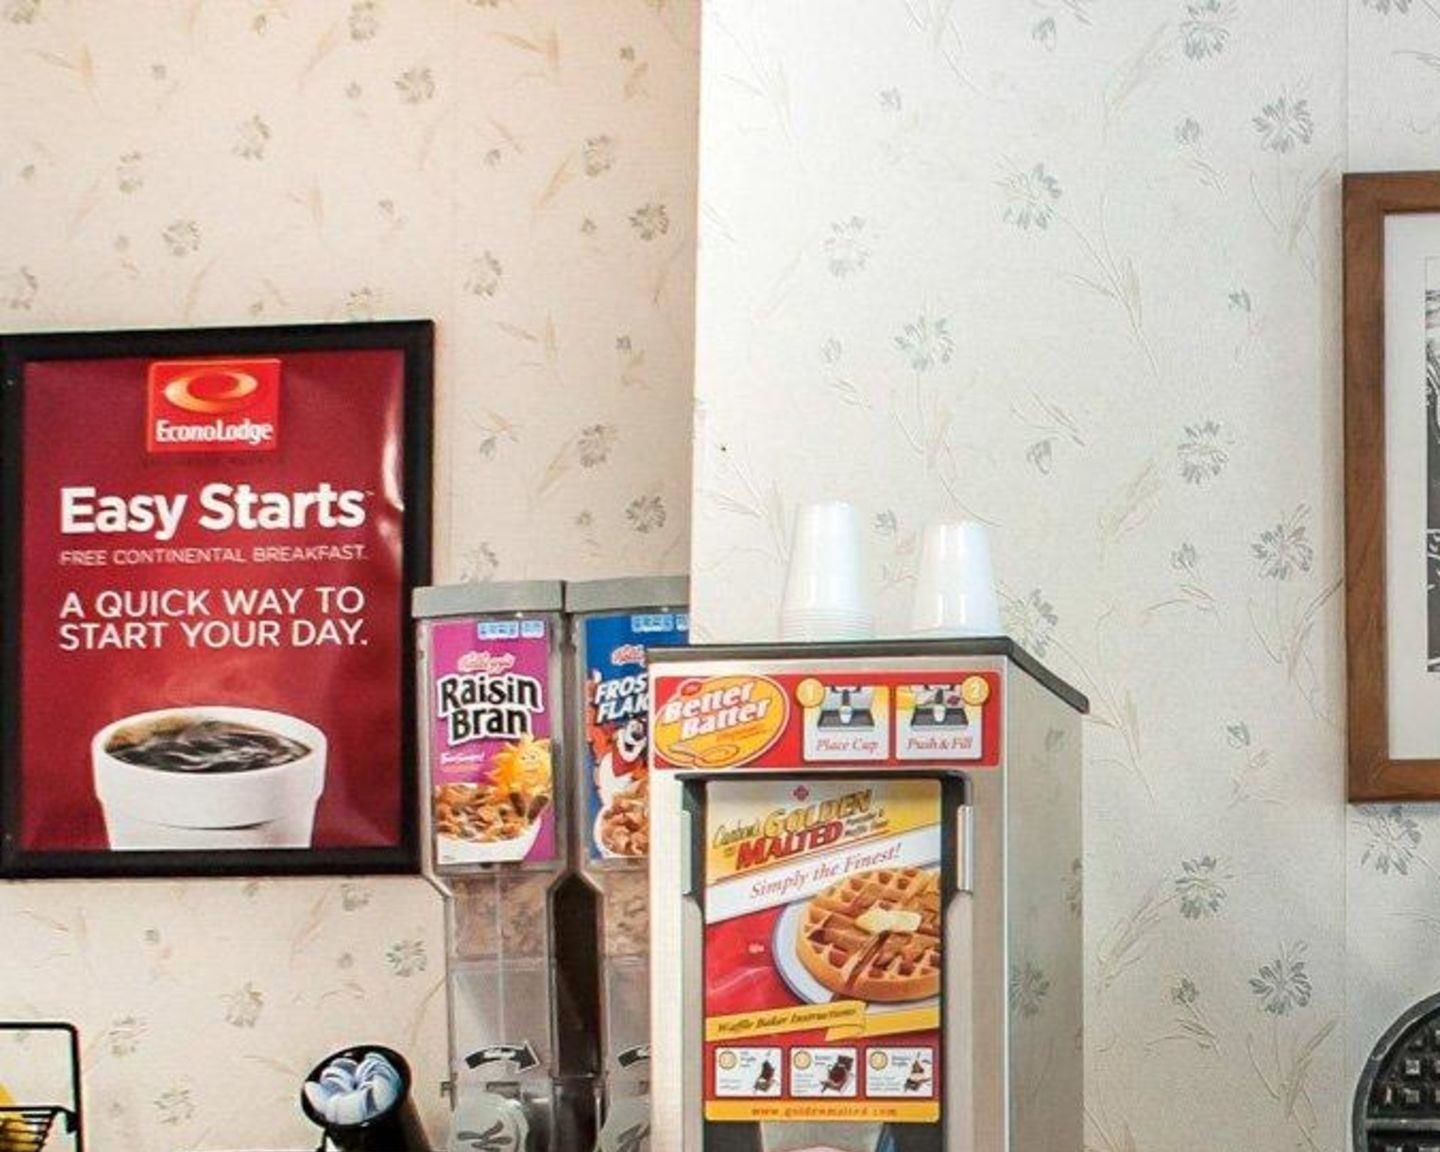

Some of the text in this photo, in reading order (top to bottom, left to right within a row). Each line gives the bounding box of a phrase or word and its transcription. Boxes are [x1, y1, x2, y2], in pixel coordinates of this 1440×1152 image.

[60, 486, 188, 540] Easy
[60, 549, 107, 566] FREE
[113, 547, 247, 565] CONTINENTAL
[60, 586, 364, 619] A QUICK WAY TO
[59, 619, 368, 651] START YOUR DAY.
[441, 675, 540, 712] Raisin
[596, 674, 648, 704] FROS
[663, 681, 754, 724] Better
[450, 708, 528, 741] Bran
[598, 695, 649, 722] FLAK
[681, 699, 772, 741] Batter
[816, 737, 879, 754] Place Cup
[763, 789, 873, 838] GOLDEN
[736, 821, 844, 870] MALTED
[751, 842, 902, 899] Simply the Finest!
